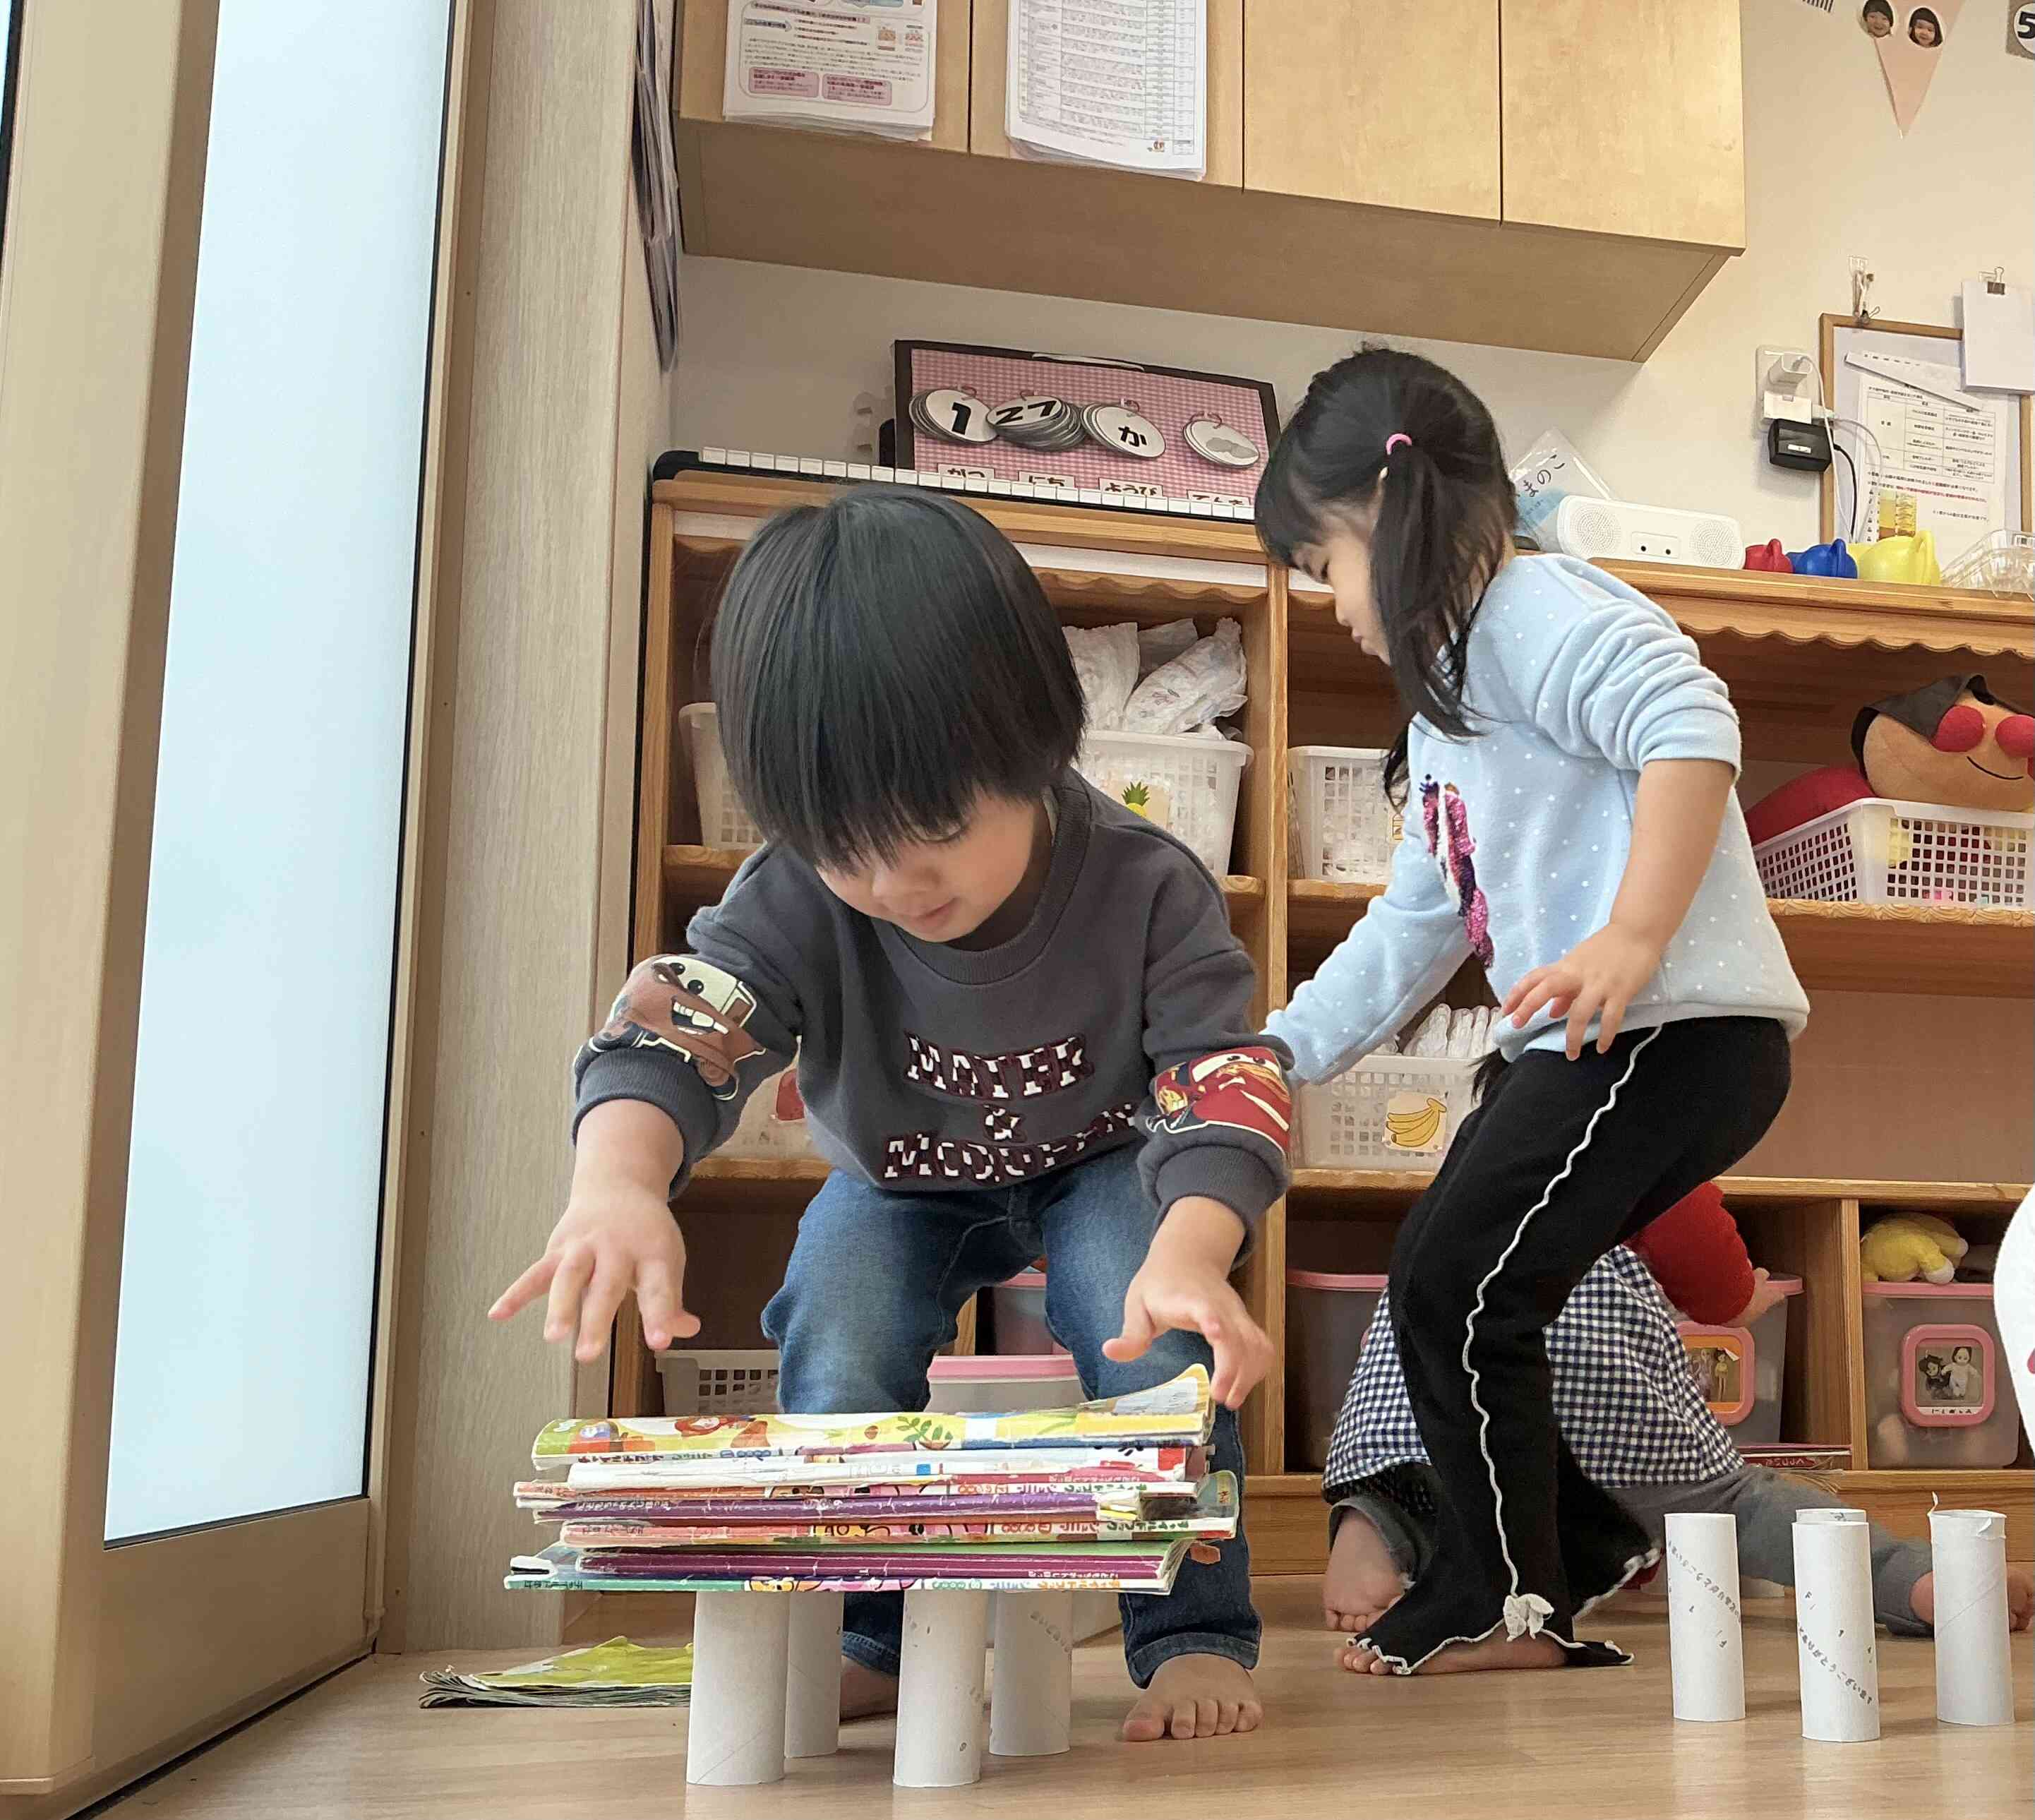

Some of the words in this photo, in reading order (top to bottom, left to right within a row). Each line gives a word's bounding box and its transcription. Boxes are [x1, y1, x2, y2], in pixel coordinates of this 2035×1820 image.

[952, 402, 972, 435] 1
[996, 400, 1058, 424] 27
[1118, 426, 1147, 447] か
[905, 1032, 1093, 1098] MATER
